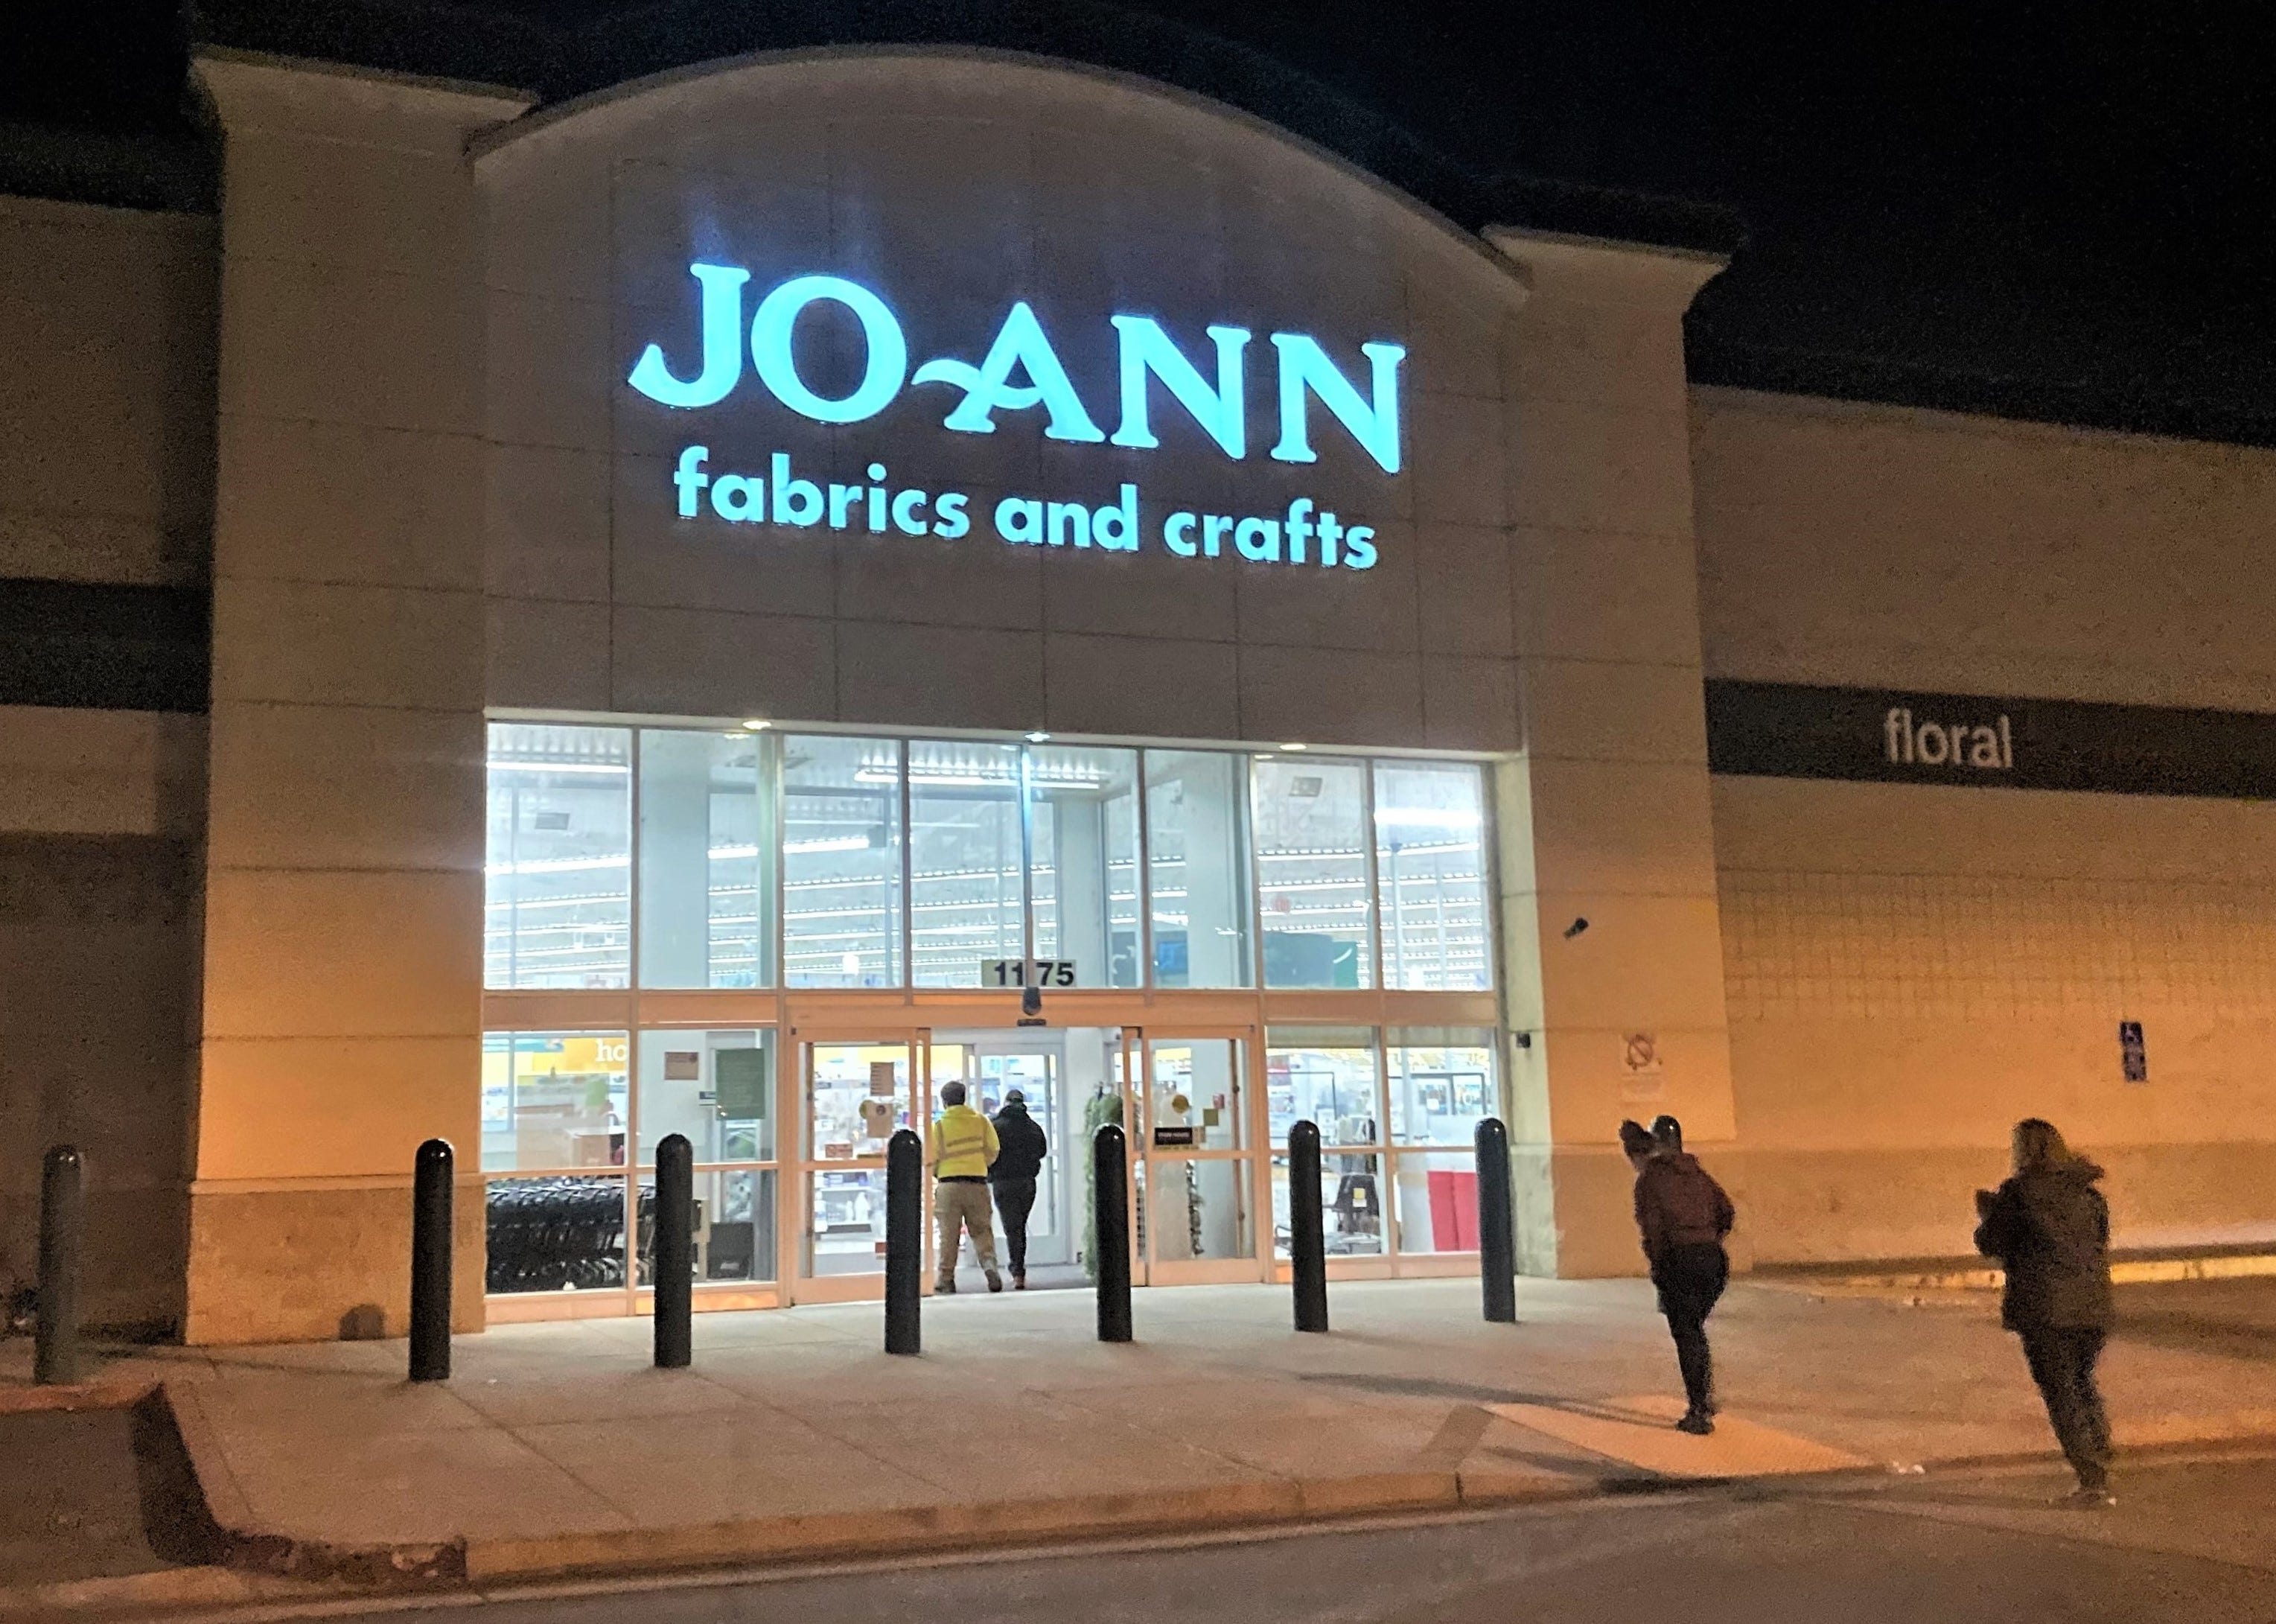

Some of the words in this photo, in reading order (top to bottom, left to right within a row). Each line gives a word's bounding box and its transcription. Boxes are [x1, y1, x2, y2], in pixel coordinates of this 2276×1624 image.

[673, 445, 970, 538] fabrics
[994, 483, 1138, 551] and
[1163, 498, 1378, 570] crafts
[1885, 707, 2012, 768] floral
[994, 961, 1074, 987] 1175
